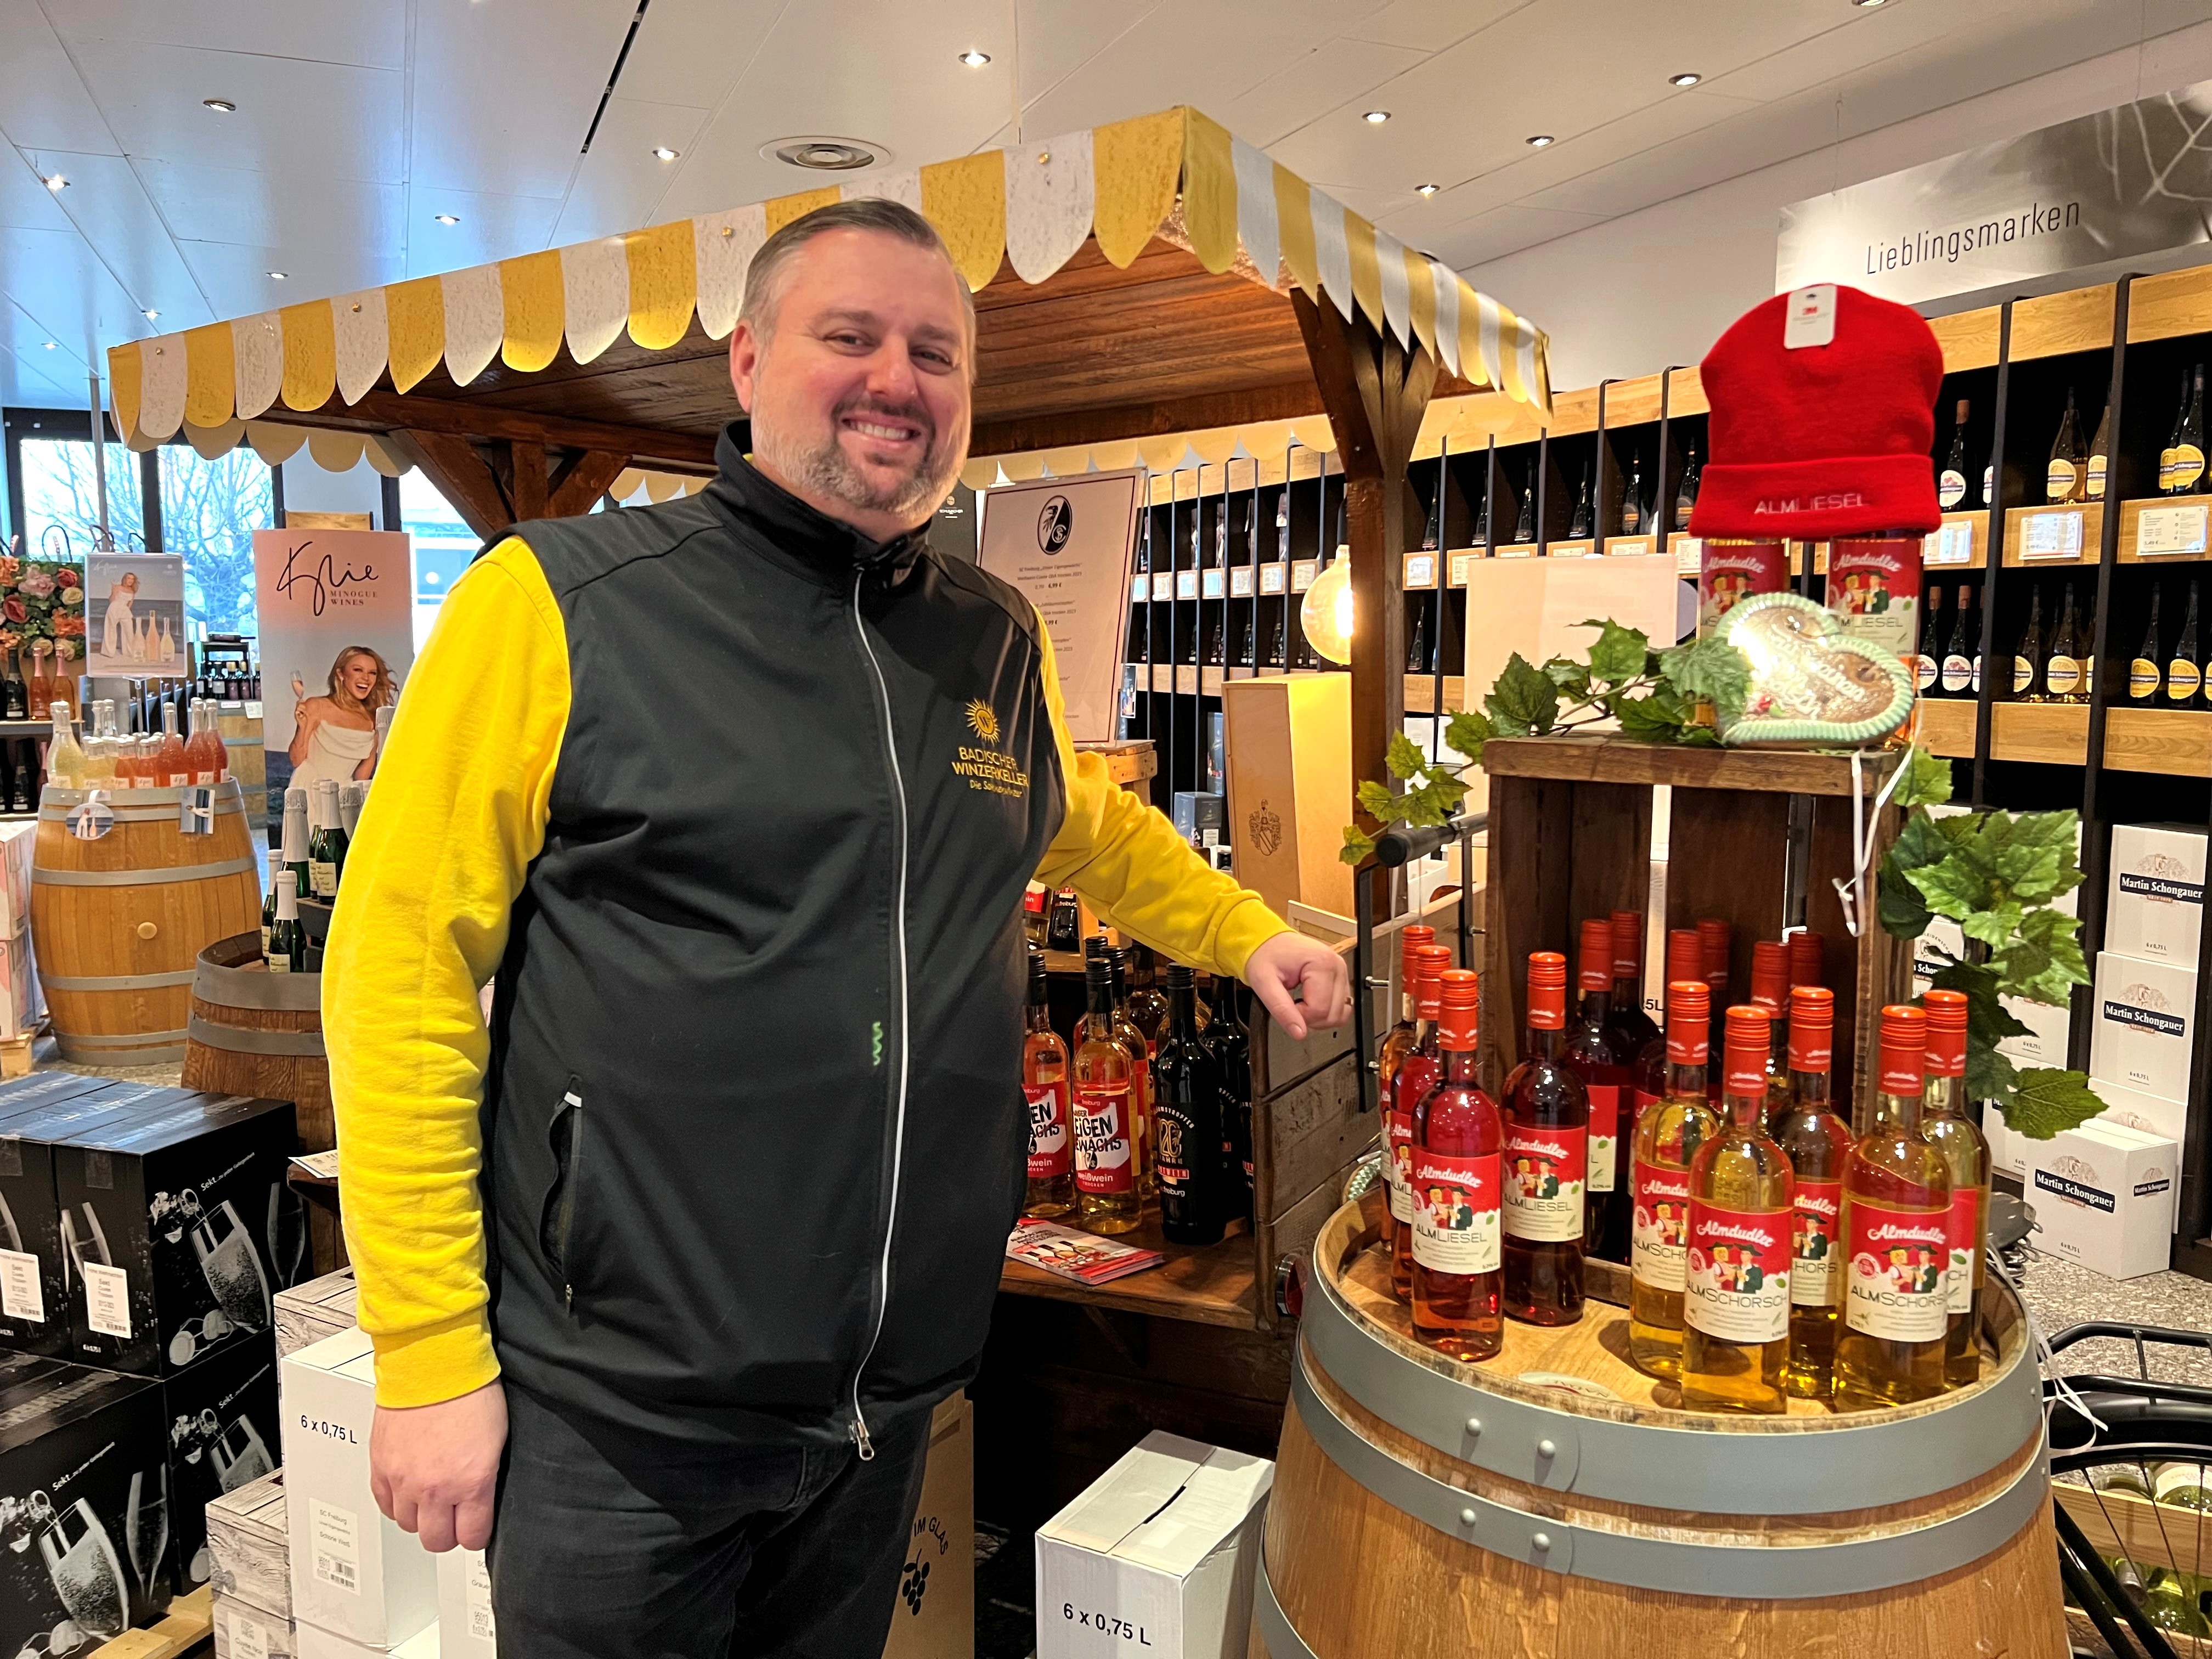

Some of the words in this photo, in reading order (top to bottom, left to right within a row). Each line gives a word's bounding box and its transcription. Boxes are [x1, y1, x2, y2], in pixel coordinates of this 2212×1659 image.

[1867, 202, 2080, 275] Lieblingsmarken
[1754, 493, 1869, 514] ALMLIESEL
[1832, 552, 1903, 572] Almdudler
[276, 541, 379, 617] Kylie
[330, 590, 378, 598] MINOGUE
[958, 746, 1018, 771] BADISCHER
[951, 761, 1029, 787] WINZERKELLER
[969, 779, 982, 790] Die
[2121, 877, 2149, 890] Martin
[2151, 882, 2203, 899] Schongauer
[2105, 1005, 2132, 1019] Martin
[2135, 1012, 2183, 1031] Schongauer
[1505, 1136, 1570, 1159] Almdudler
[201, 1177, 217, 1191] Sekt
[1416, 1164, 1484, 1188] Almdudler
[2036, 1173, 2063, 1190] Martin
[2065, 1183, 2113, 1207] Schongauer
[1504, 1193, 1573, 1212] ALMLIESEL
[1416, 1223, 1487, 1244] ALMLIESEL
[1696, 1220, 1775, 1247] Almdudler
[1686, 1279, 1787, 1308] ALMSCHORSCH
[301, 1414, 307, 1428] 6
[311, 1420, 318, 1432] x
[322, 1421, 346, 1440] 0,75
[350, 1430, 357, 1444] L
[52, 1474, 70, 1491] Sekt
[914, 1517, 926, 1537] IM
[929, 1516, 949, 1555] GLAS
[1063, 1602, 1074, 1620] 6
[1079, 1610, 1090, 1626] x
[1095, 1613, 1133, 1639] 0,75
[1140, 1627, 1152, 1646] L
